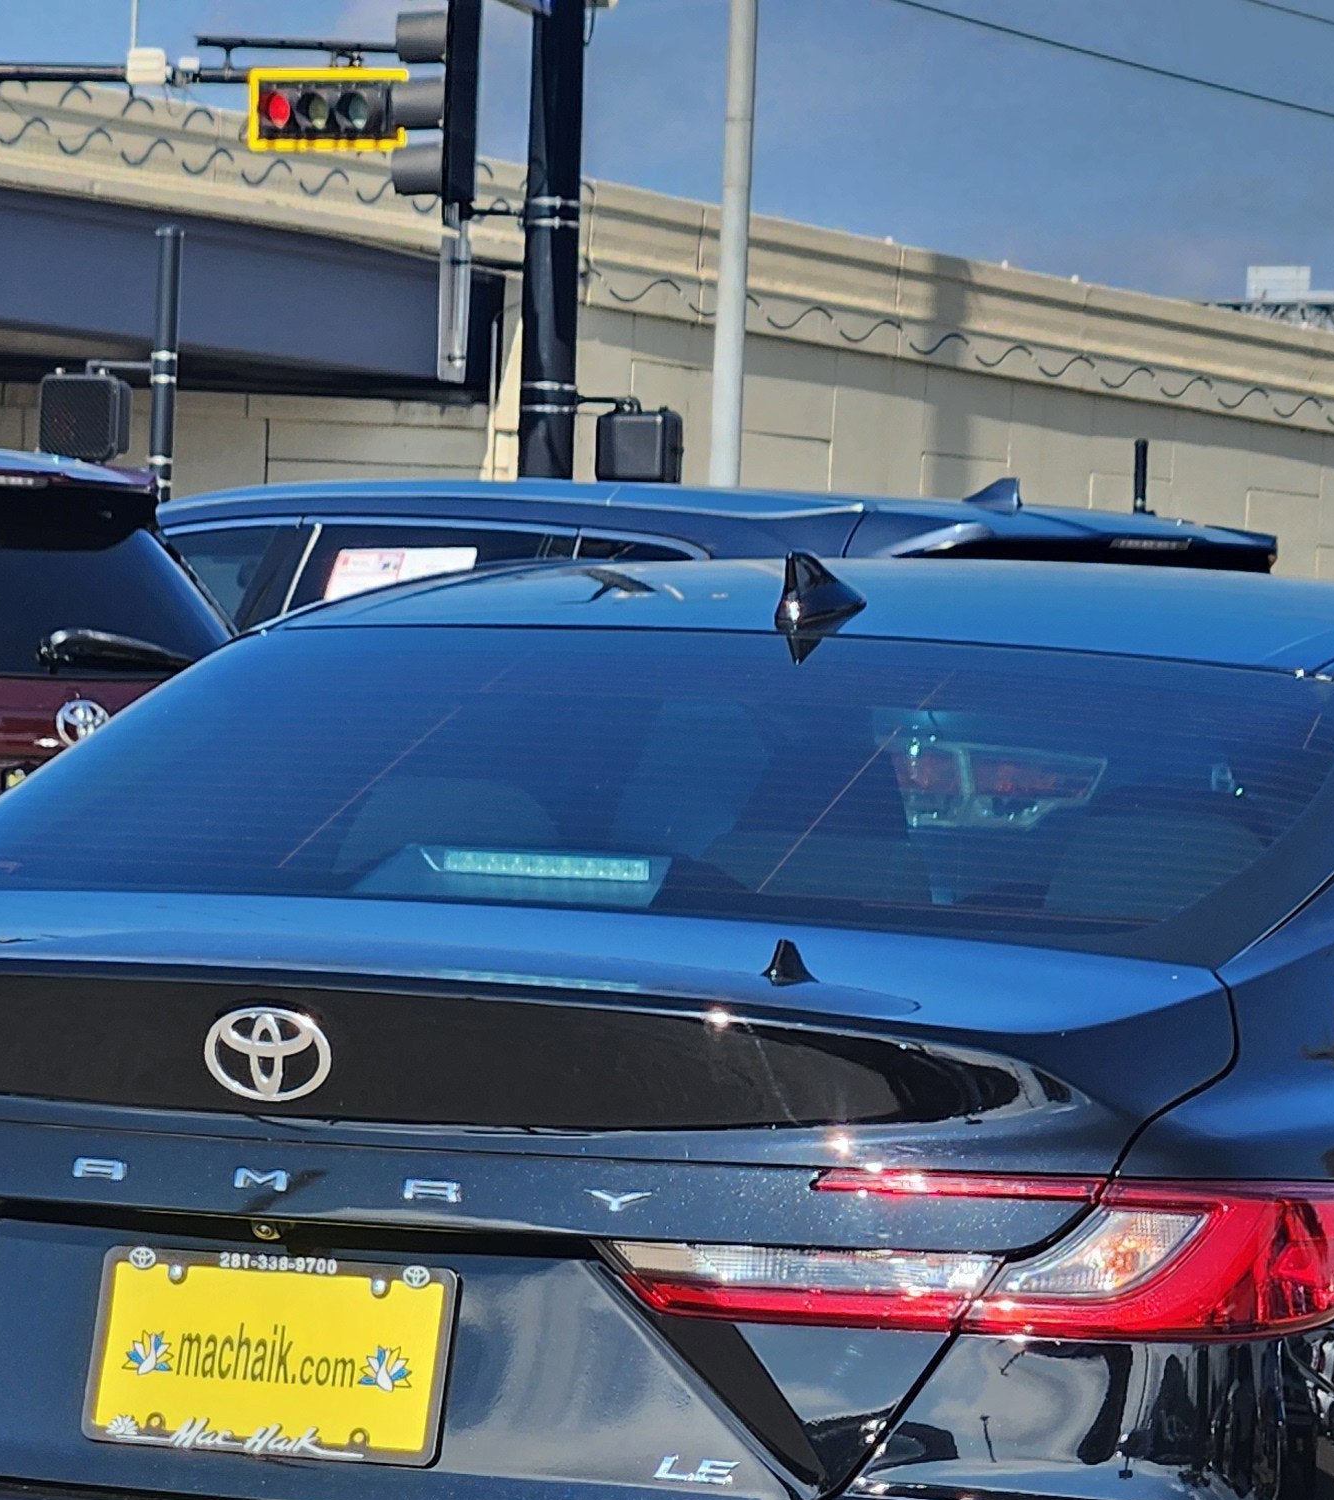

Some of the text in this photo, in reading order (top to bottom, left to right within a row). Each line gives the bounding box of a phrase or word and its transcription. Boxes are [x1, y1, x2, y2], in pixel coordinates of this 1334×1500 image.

[219, 1251, 338, 1275] 281-338-9700
[175, 1322, 357, 1389] machaik.com
[652, 1454, 741, 1486] LE
